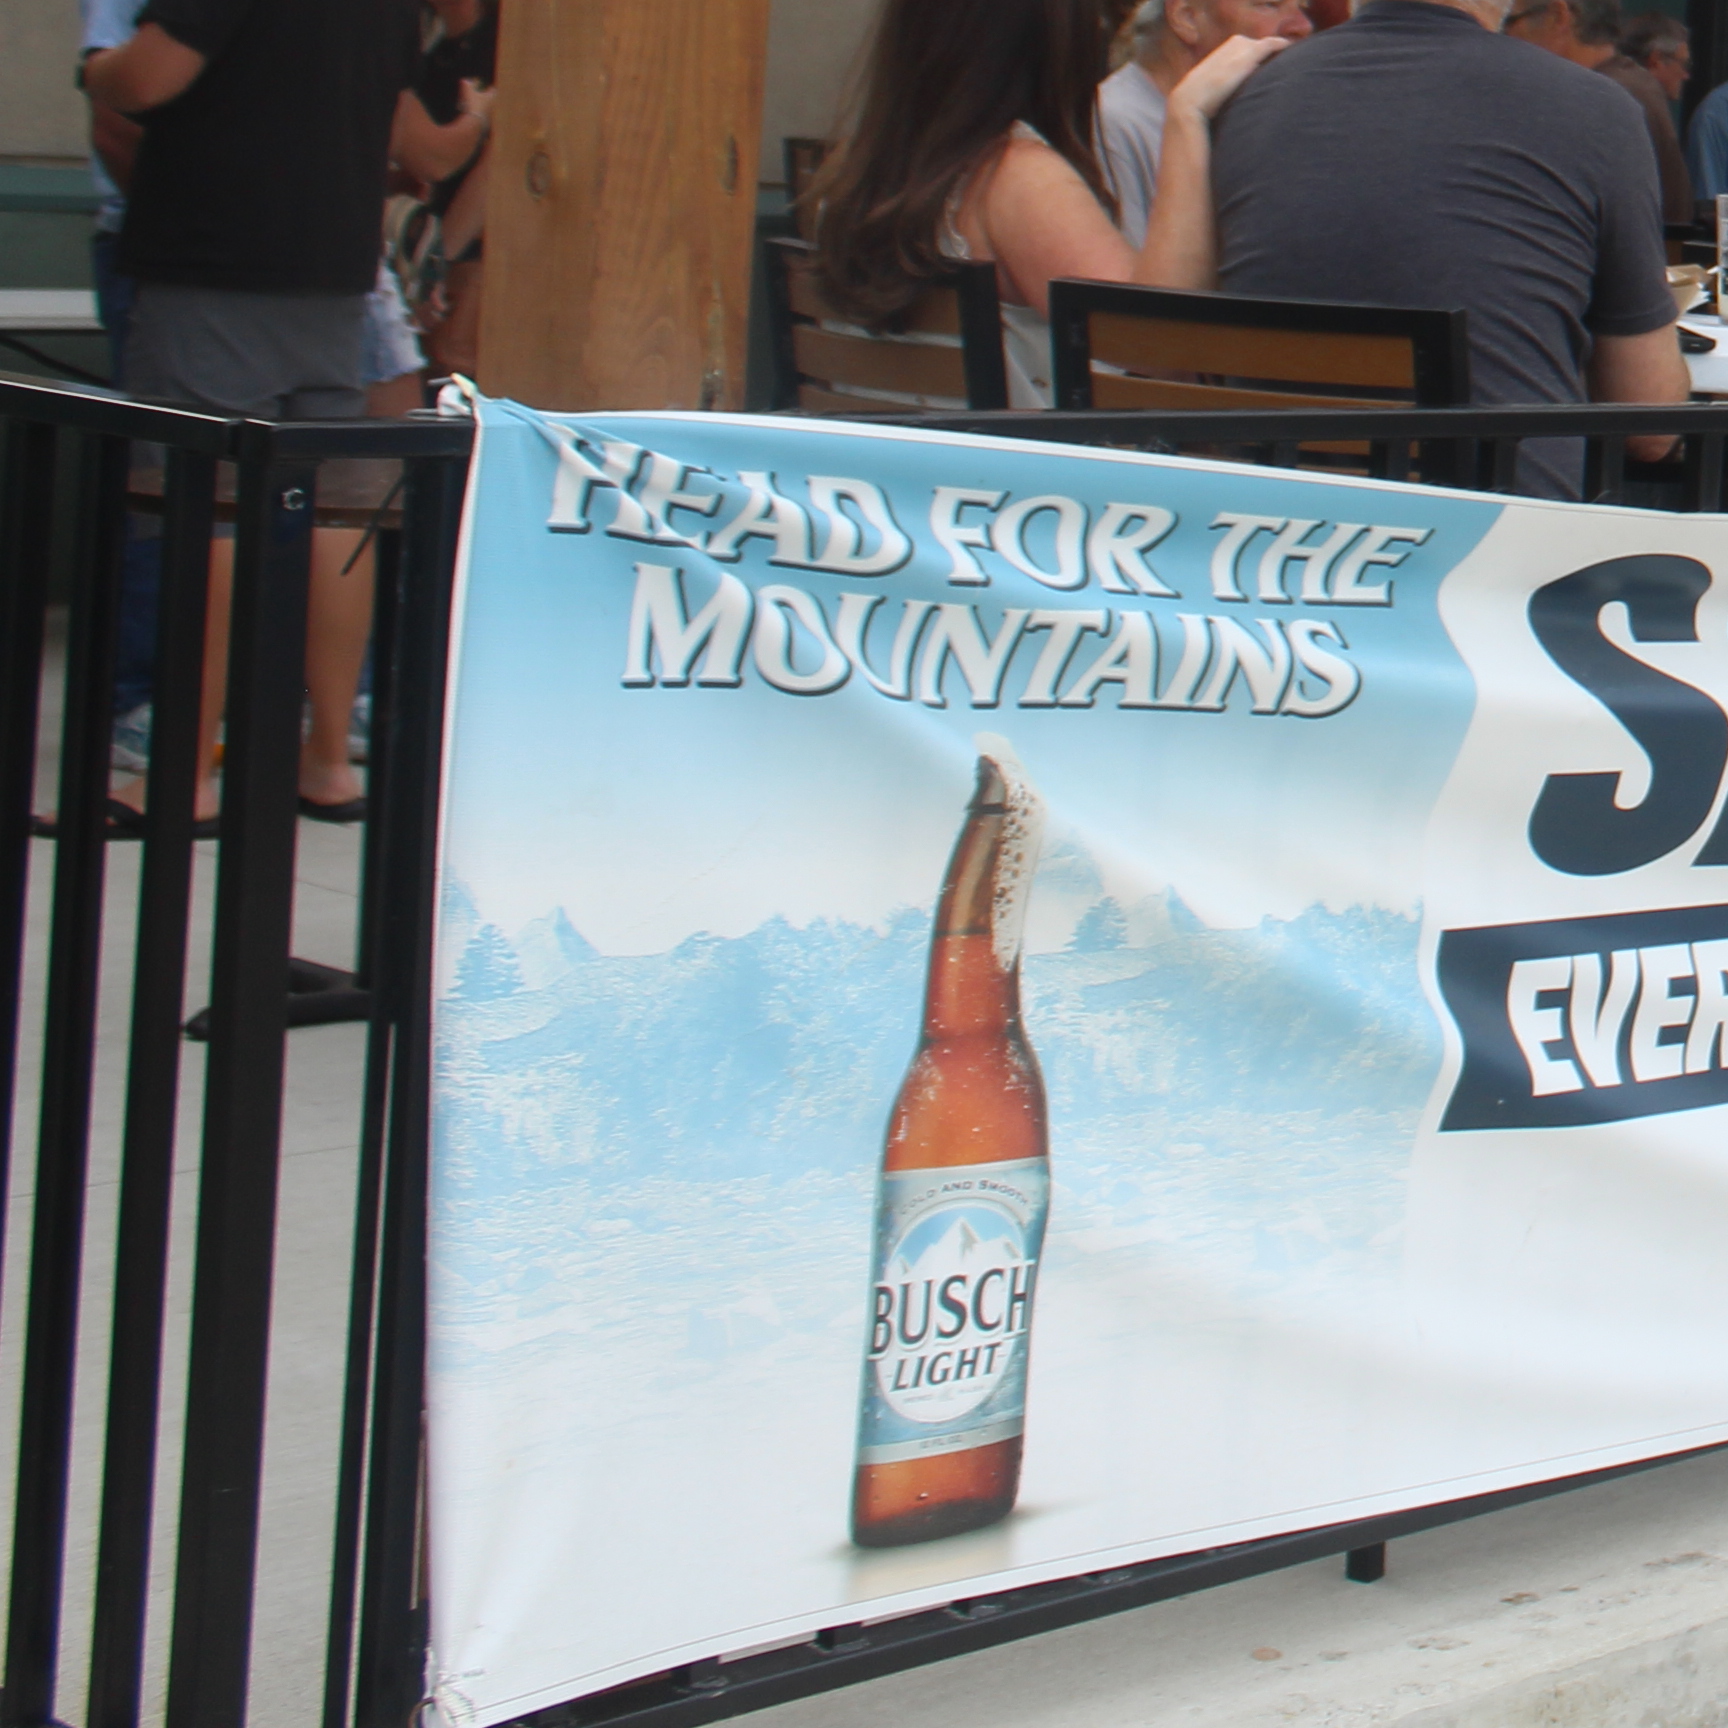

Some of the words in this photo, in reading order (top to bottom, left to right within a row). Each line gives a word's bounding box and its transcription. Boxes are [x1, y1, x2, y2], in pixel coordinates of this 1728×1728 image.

[547, 430, 914, 578] HEAD
[930, 485, 1182, 600] FOR
[1207, 509, 1434, 607] THE
[620, 562, 1361, 718] MOUNTAINS
[940, 1180, 973, 1194] AND
[868, 1263, 1034, 1358] BUSCH
[890, 1341, 1003, 1392] LIGHT
